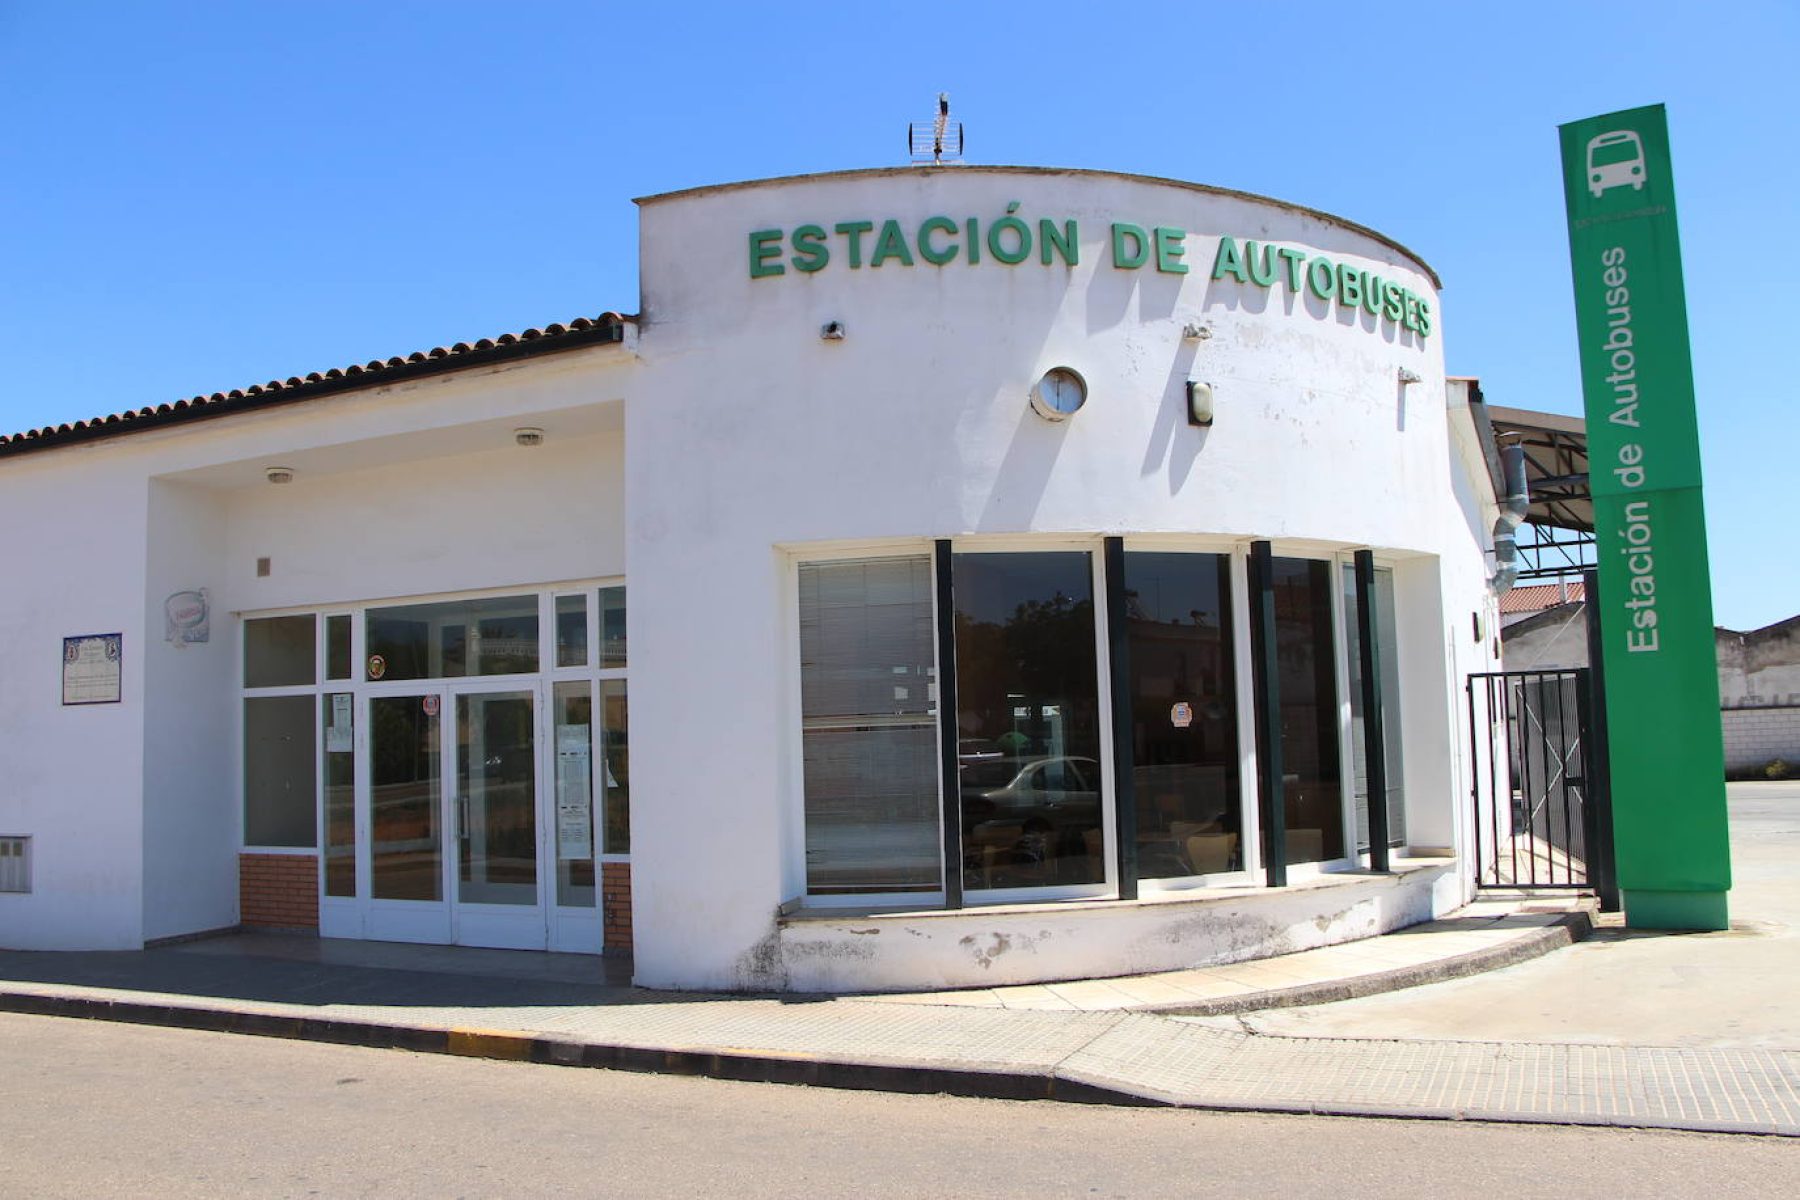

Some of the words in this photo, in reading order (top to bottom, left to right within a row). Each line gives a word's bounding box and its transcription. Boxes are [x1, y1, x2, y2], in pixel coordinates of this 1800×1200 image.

[749, 201, 1079, 278] ESTACIÓN
[1111, 222, 1190, 274] DE
[1211, 236, 1433, 338] AUTOBUSES
[1601, 246, 1641, 428] Autobuses
[1613, 444, 1646, 488] de
[1618, 502, 1659, 653] Estación
